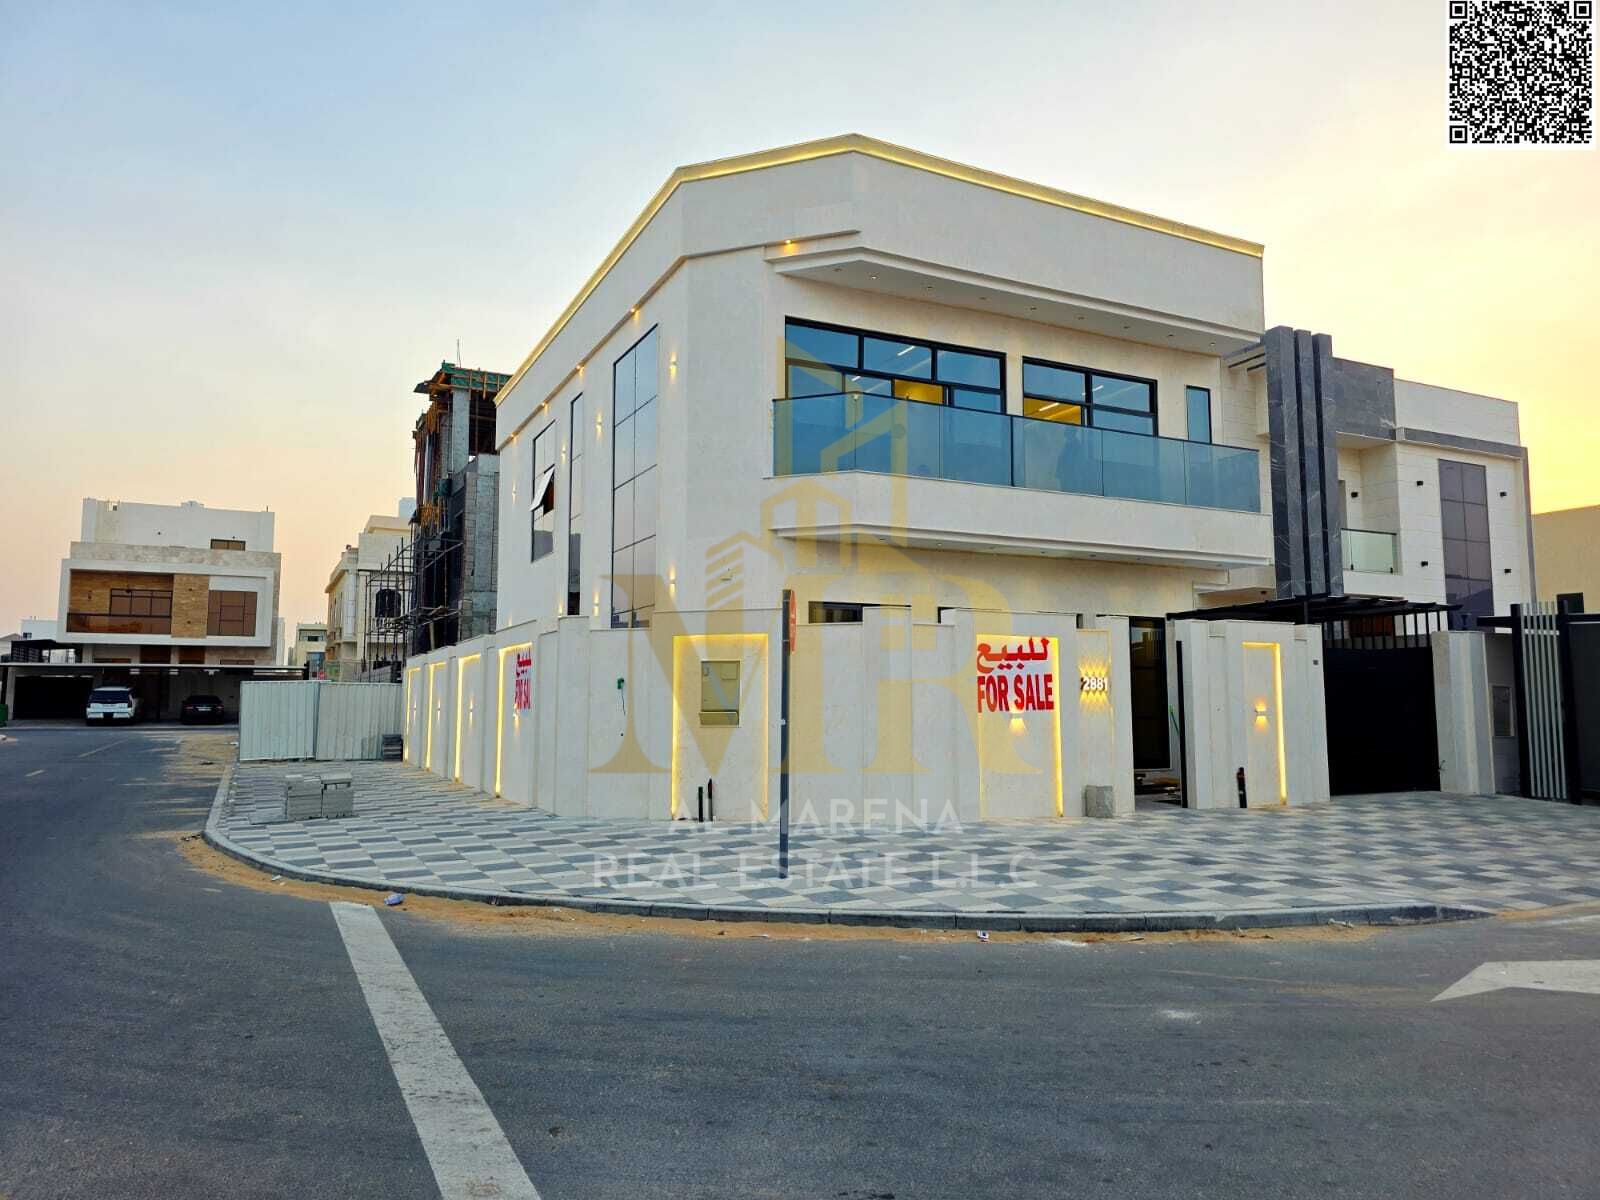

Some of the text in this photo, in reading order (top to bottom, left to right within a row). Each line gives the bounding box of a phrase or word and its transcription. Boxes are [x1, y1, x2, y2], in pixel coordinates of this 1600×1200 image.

[977, 637, 1050, 674] للبيع
[976, 673, 1055, 713] FOR SALE
